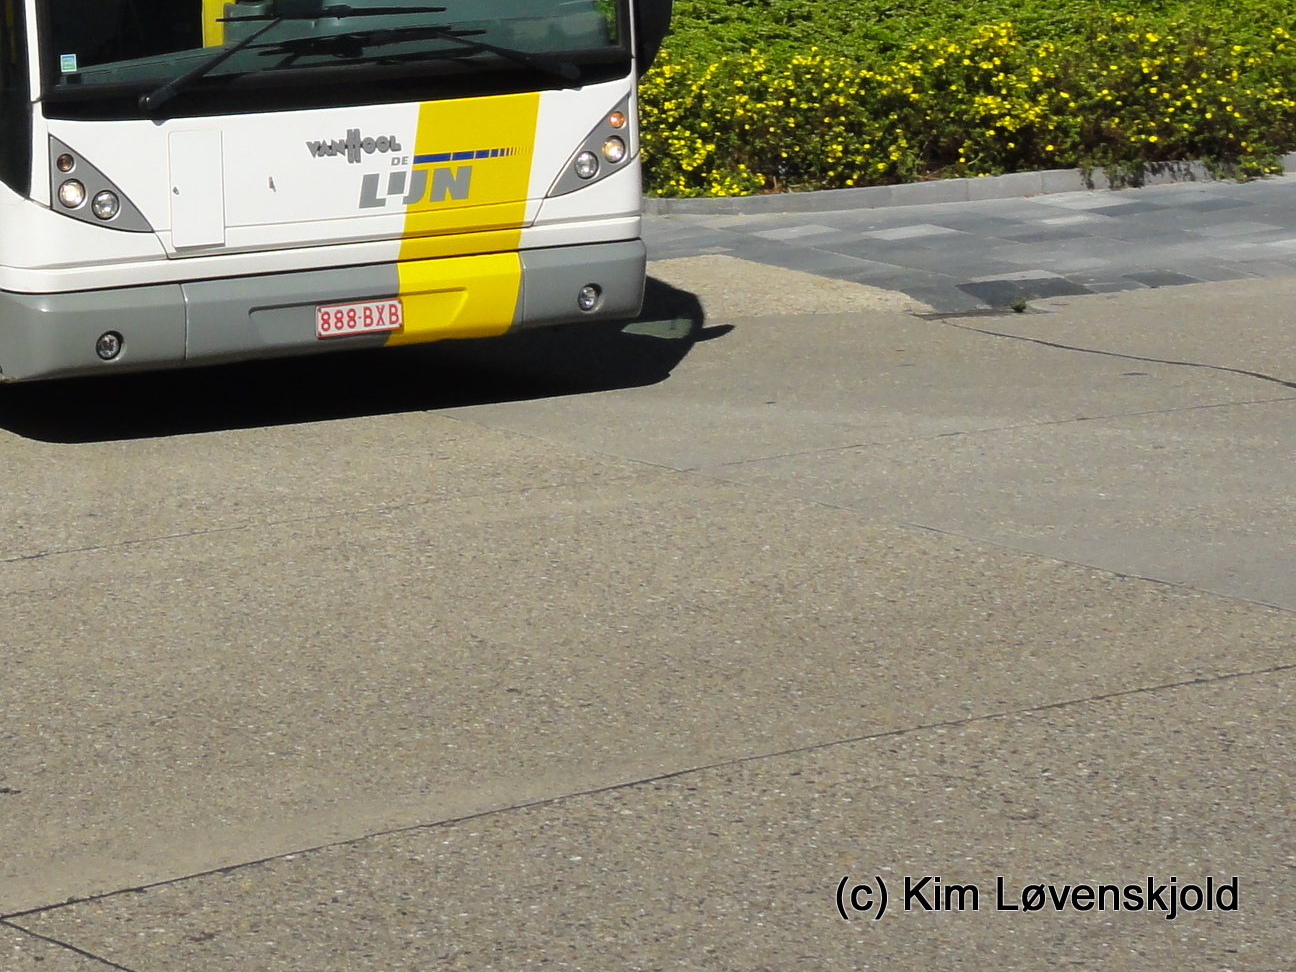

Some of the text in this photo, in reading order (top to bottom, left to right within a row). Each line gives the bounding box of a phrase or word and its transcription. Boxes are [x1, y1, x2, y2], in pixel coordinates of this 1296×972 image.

[390, 155, 409, 166] DE
[358, 165, 473, 209] LIJN
[320, 303, 400, 332] 888-BXB
